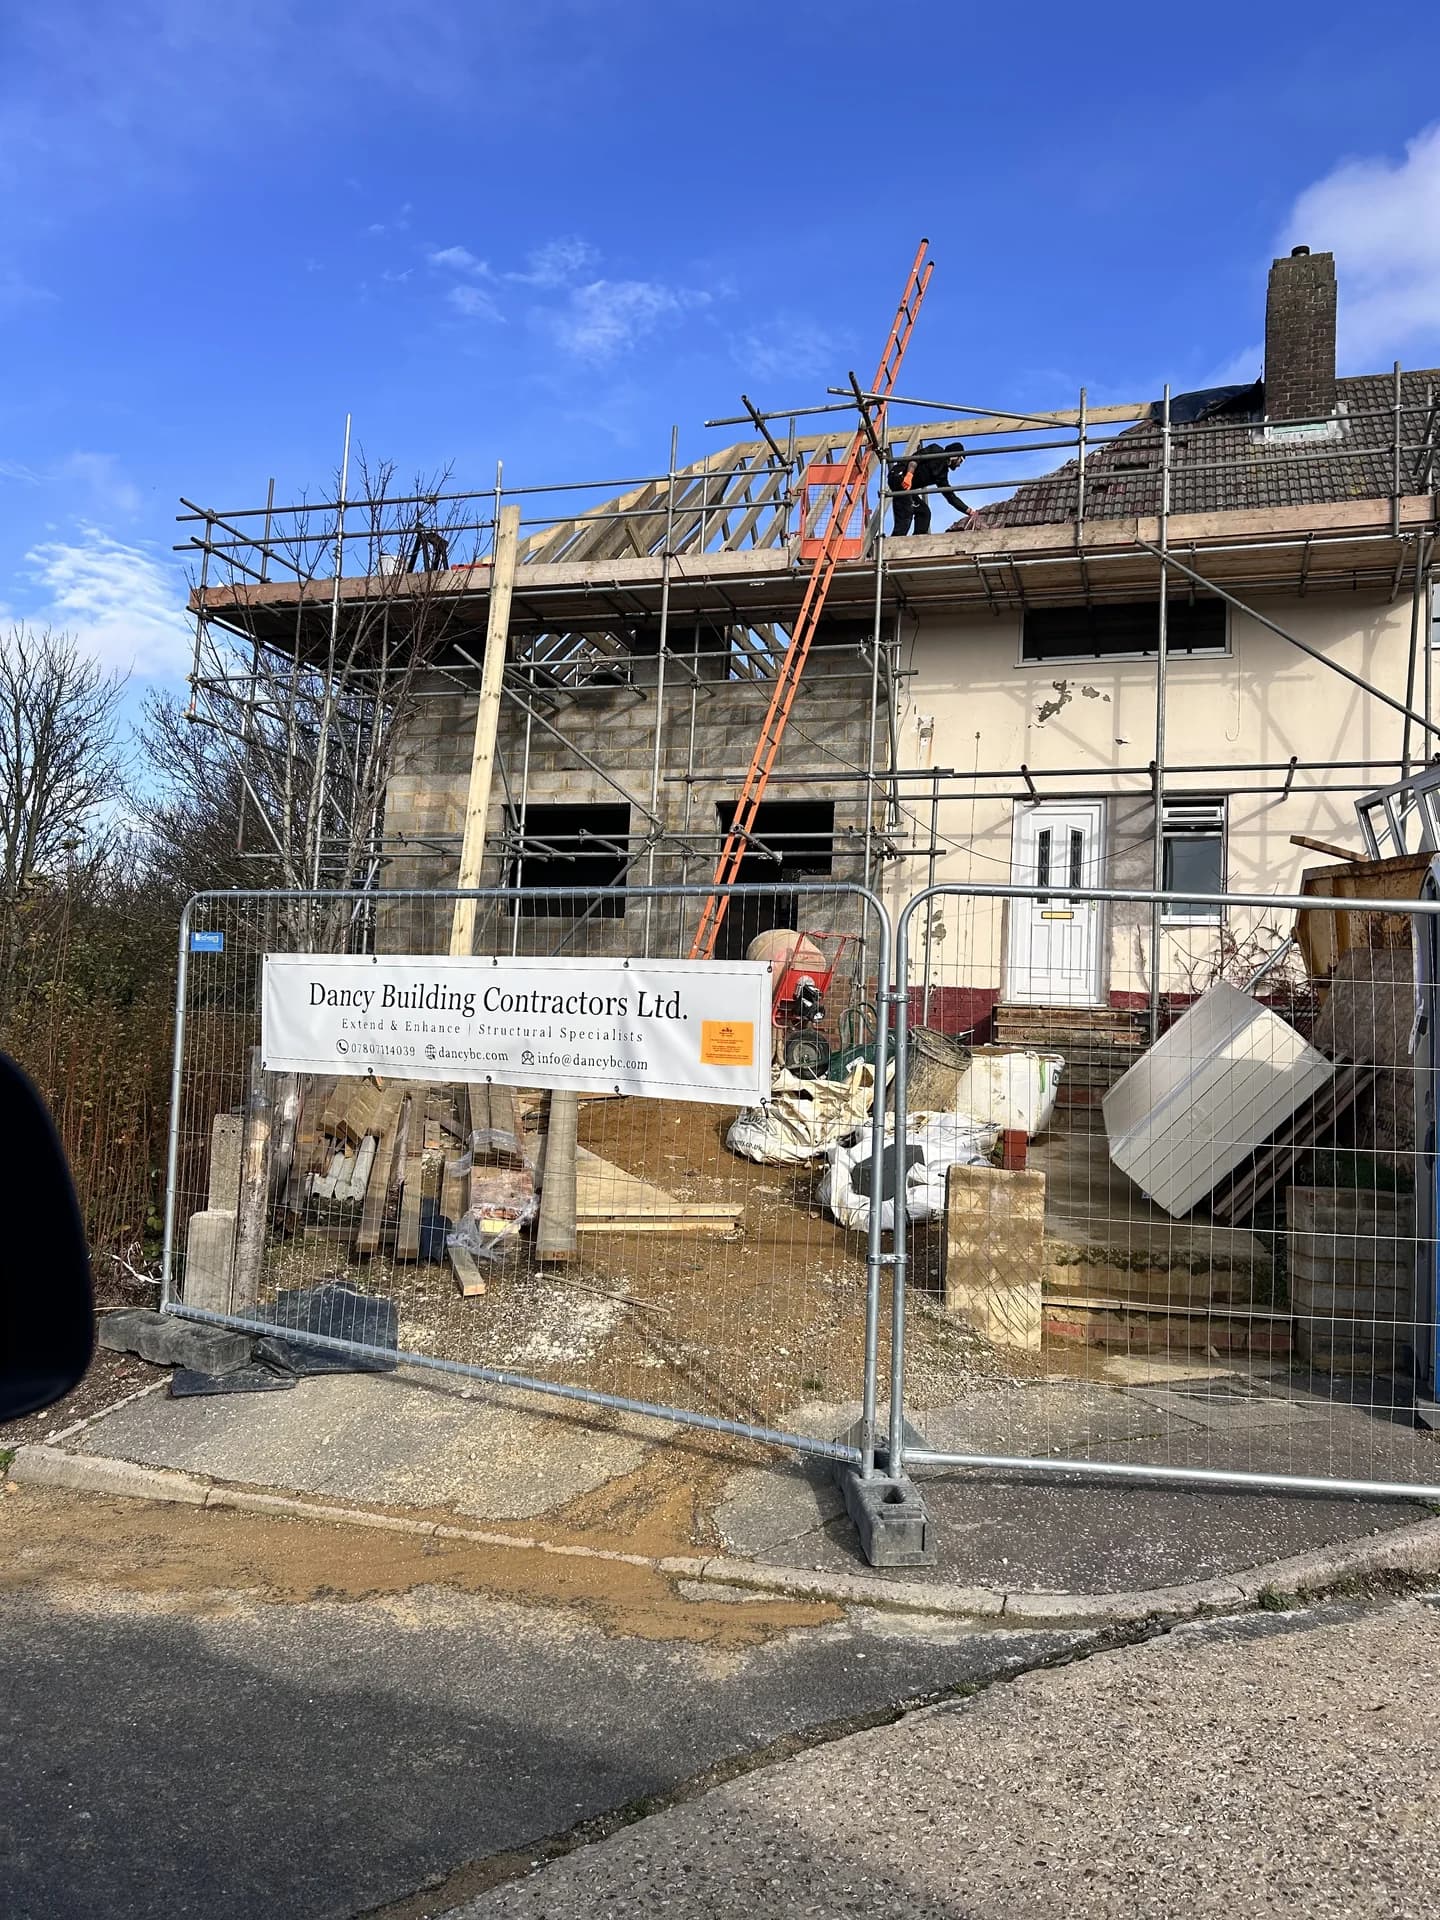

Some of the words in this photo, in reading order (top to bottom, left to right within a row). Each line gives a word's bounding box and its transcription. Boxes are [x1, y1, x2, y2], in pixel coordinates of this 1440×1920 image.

[309, 982, 375, 1014] Dancy
[381, 983, 477, 1018] Building
[483, 986, 628, 1017] Contractors
[637, 990, 688, 1020] Ltd.
[342, 1018, 385, 1031] Extend
[390, 1021, 398, 1031] &
[405, 1021, 461, 1034] Enhance
[478, 1023, 553, 1038] Structural
[559, 1027, 643, 1042] Specialists
[438, 1045, 509, 1062] dancybc.com
[537, 1051, 648, 1070] info@dancybc.com
